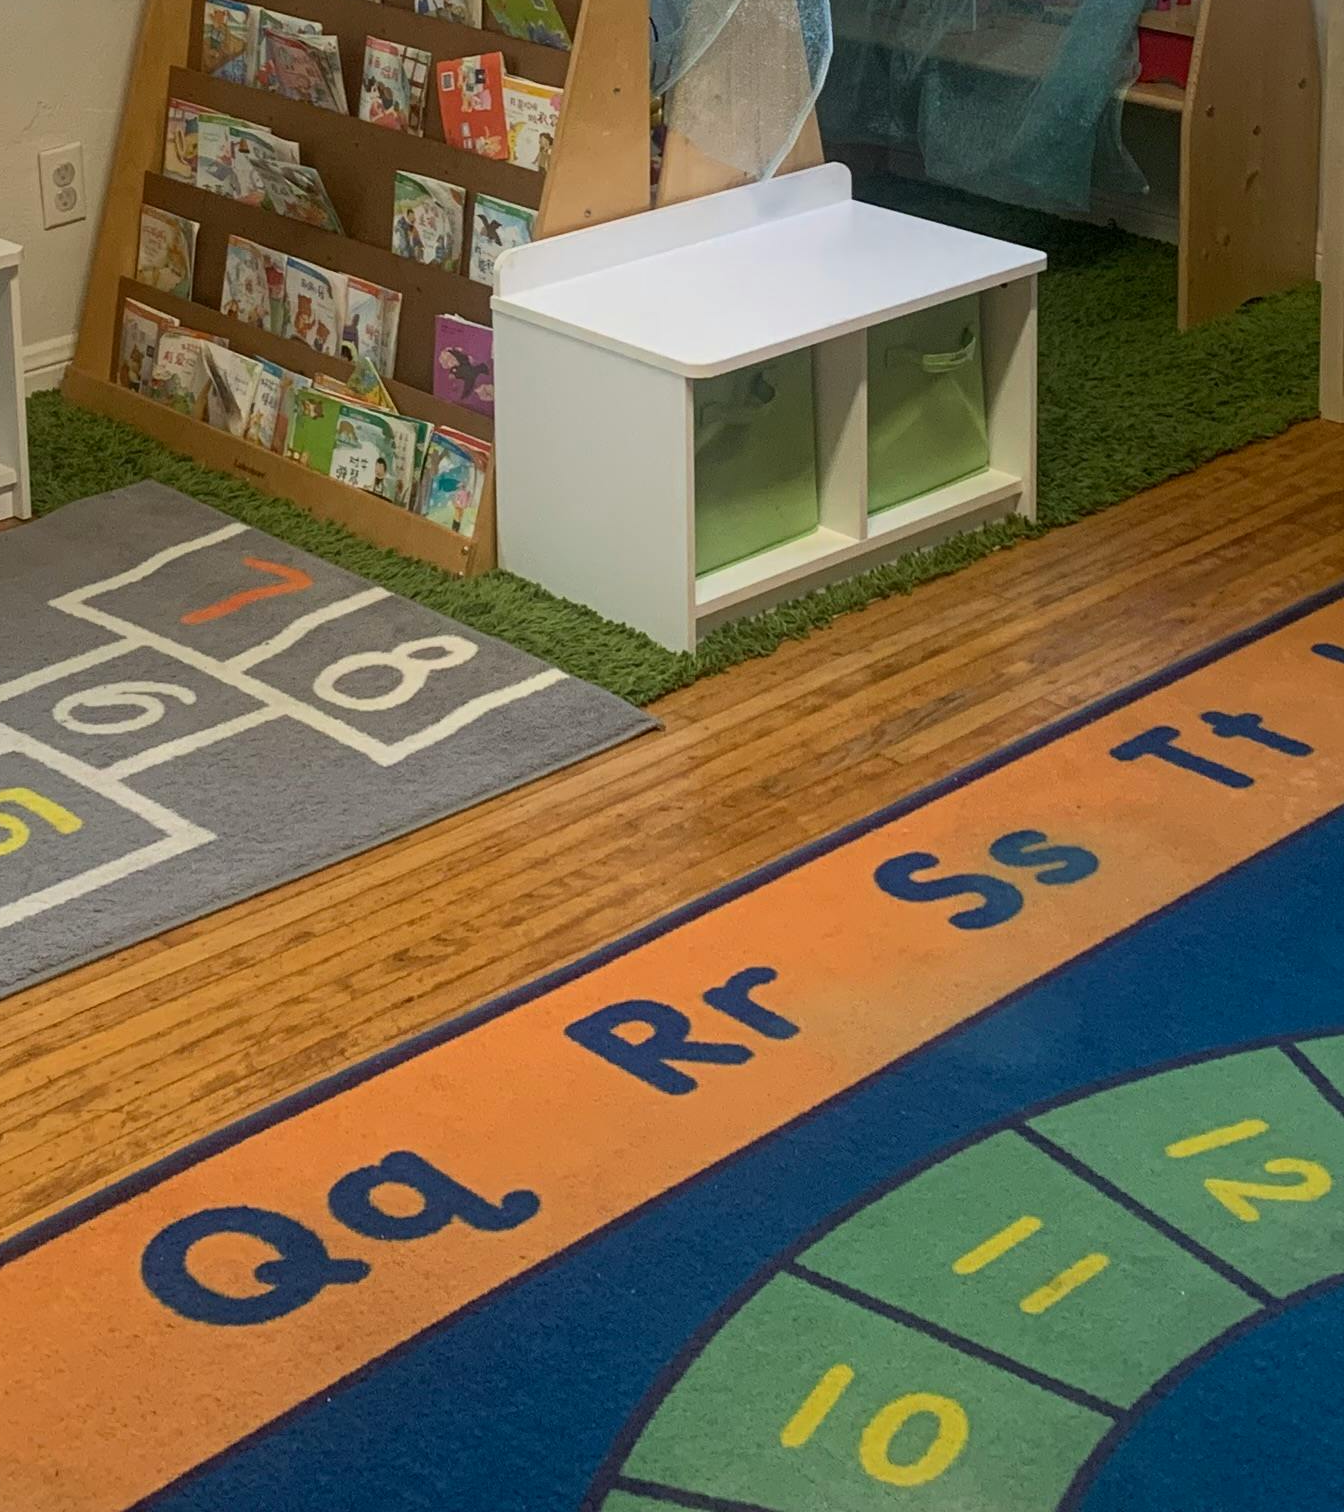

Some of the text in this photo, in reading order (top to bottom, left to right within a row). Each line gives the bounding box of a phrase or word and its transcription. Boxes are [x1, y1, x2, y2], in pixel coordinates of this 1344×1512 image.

[180, 555, 316, 626] 7
[51, 680, 199, 736] 6
[312, 633, 481, 713] 8
[141, 1148, 542, 1328] Qq
[563, 965, 801, 1095] Rr
[873, 828, 1102, 931] Ss
[1109, 709, 1312, 789] Tt
[1165, 1119, 1333, 1221] 12
[952, 1215, 1109, 1314] 11
[781, 1363, 970, 1487] 10
